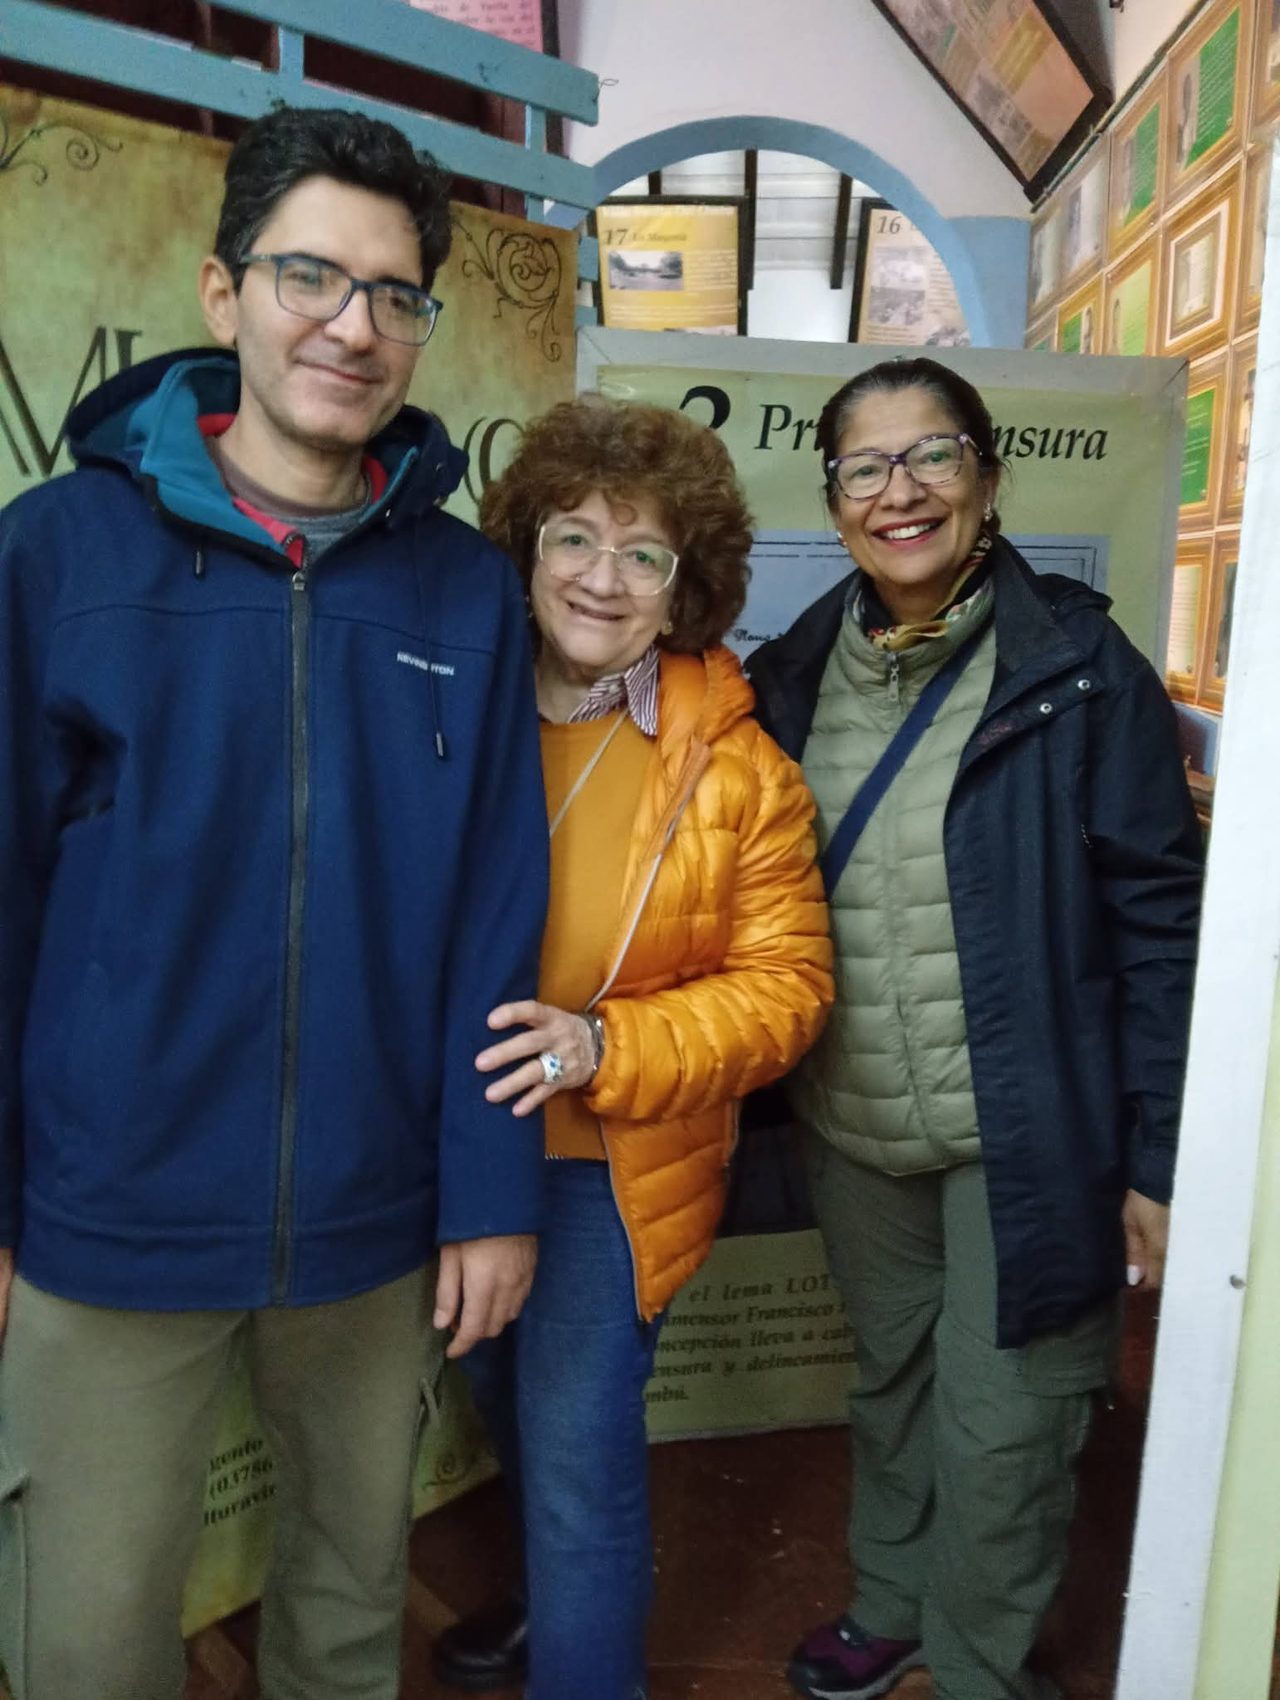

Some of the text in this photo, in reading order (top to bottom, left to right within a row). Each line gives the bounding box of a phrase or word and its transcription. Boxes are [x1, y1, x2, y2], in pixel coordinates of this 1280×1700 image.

[603, 228, 629, 246] 17
[877, 215, 903, 235] 16
[992, 425, 1108, 461] nsura
[722, 1281, 773, 1300] lema
[785, 1272, 832, 1295] LOT
